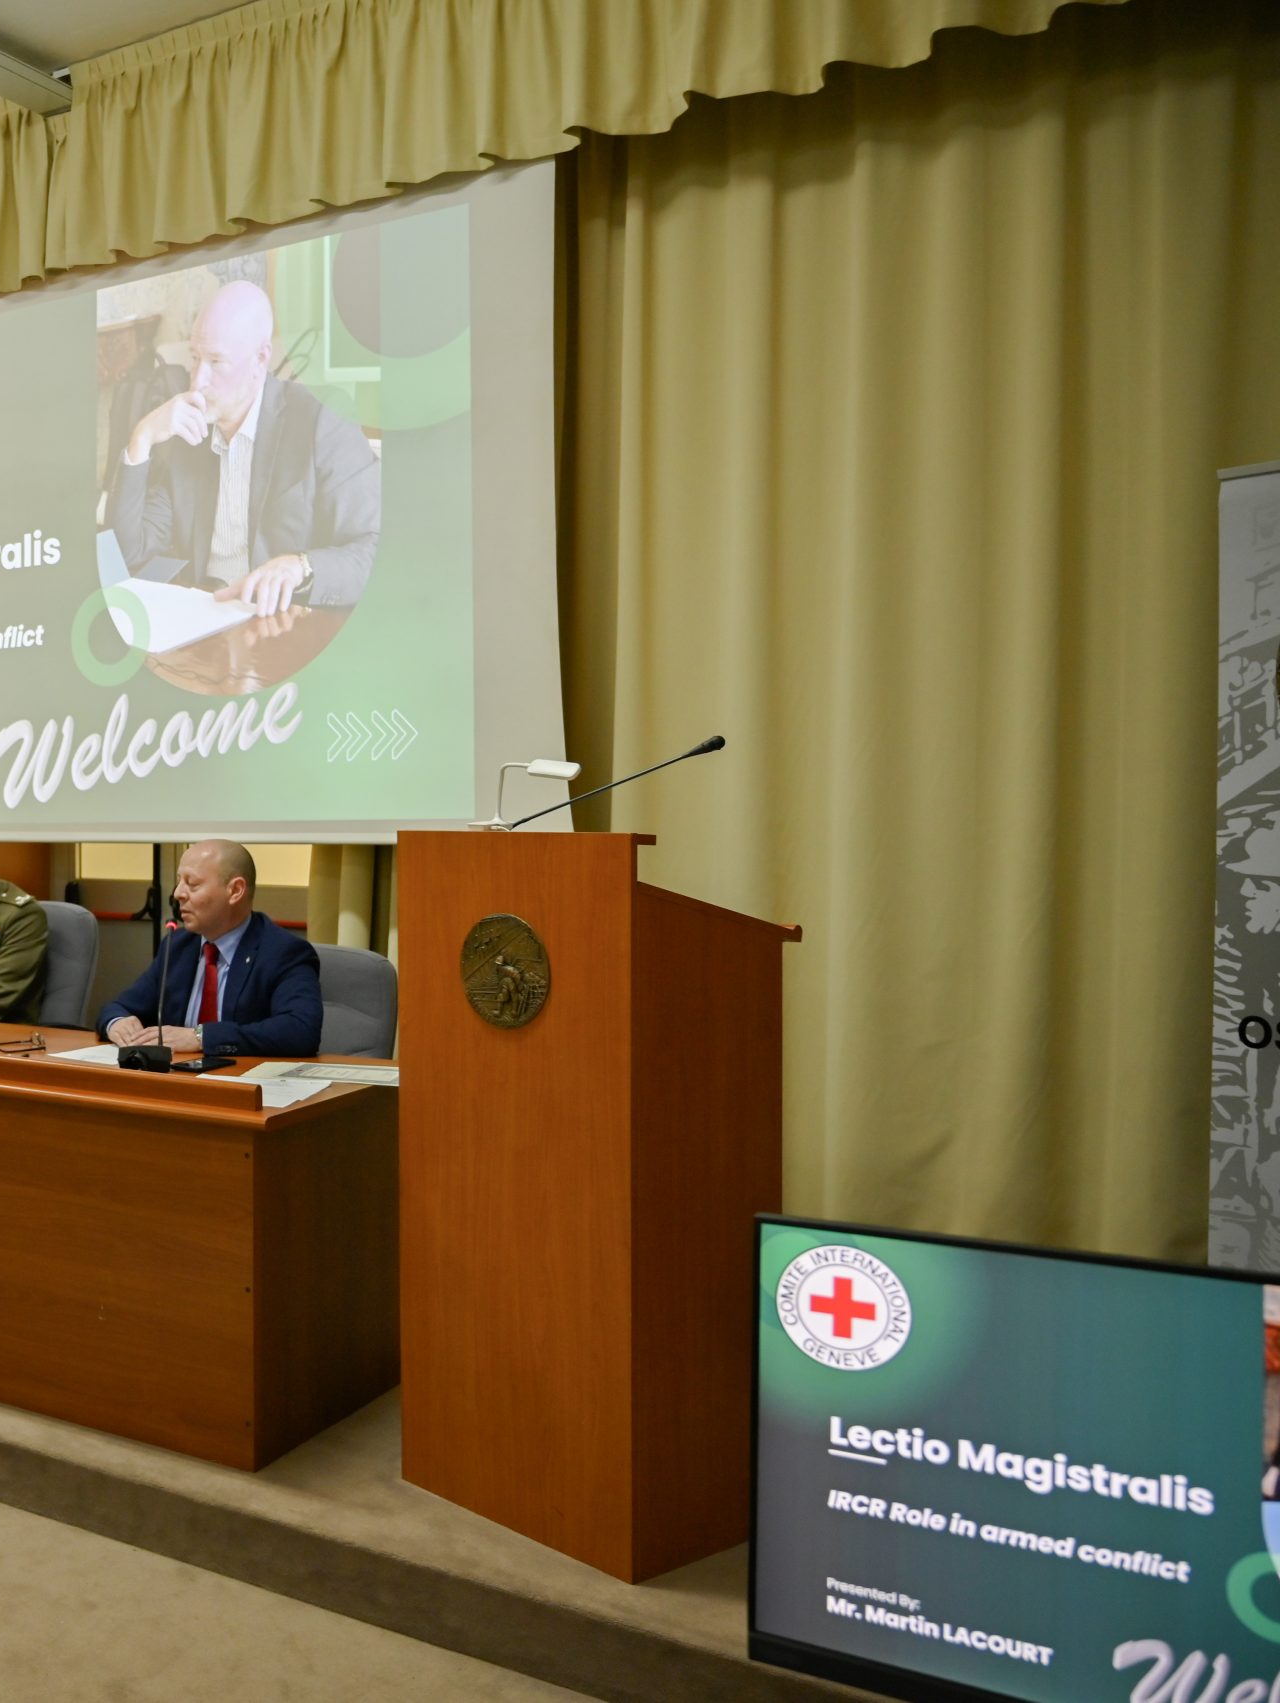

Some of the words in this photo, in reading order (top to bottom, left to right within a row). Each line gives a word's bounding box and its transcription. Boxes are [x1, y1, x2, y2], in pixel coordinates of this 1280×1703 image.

[780, 1261, 808, 1326] COMITE
[809, 1248, 907, 1343] INTERNATIONAL
[802, 1337, 881, 1367] GENEVE
[829, 1415, 950, 1465] Lectio
[957, 1439, 1215, 1516] Magistralis
[827, 1489, 887, 1519] IRCR
[889, 1500, 946, 1532] Role
[949, 1512, 976, 1538] in
[979, 1523, 1075, 1559] armed
[1077, 1544, 1191, 1584] conflict
[826, 1577, 896, 1605] Presented
[899, 1594, 921, 1611] By:
[826, 1595, 863, 1621] Mr.
[864, 1604, 940, 1639] Martin
[943, 1623, 1054, 1666] LACOURT
